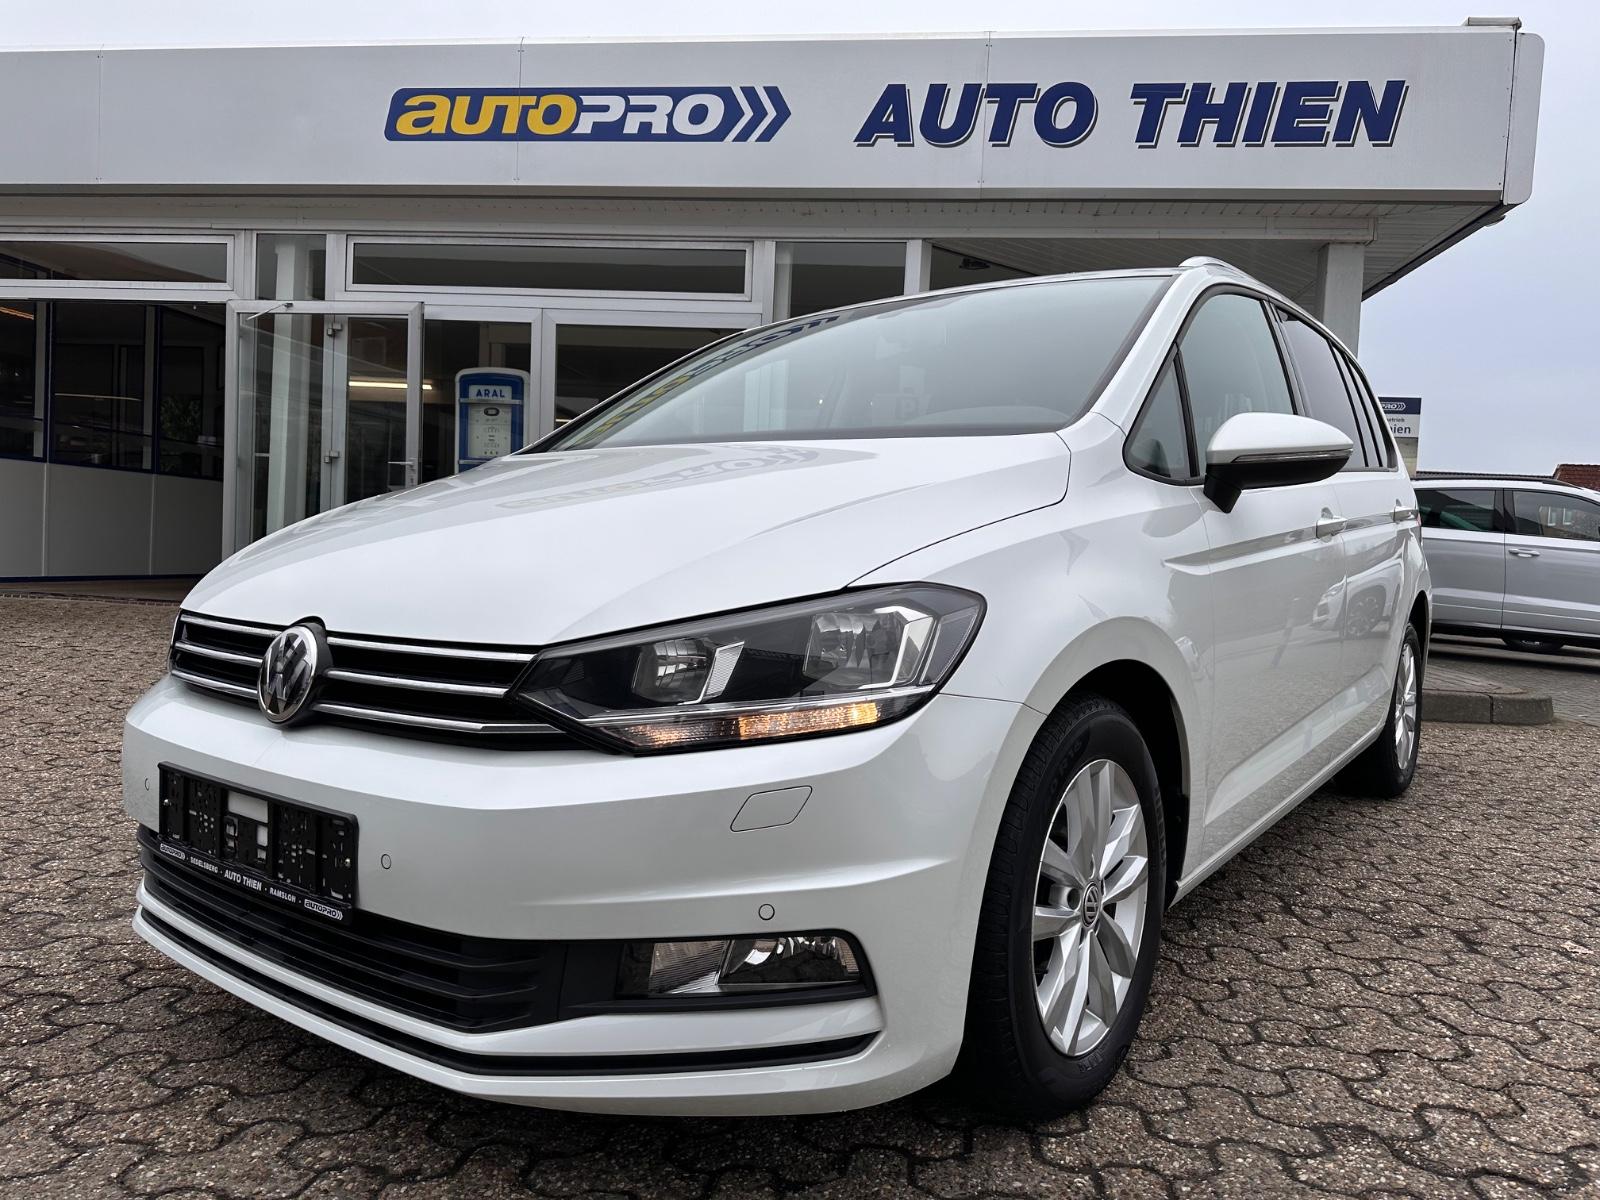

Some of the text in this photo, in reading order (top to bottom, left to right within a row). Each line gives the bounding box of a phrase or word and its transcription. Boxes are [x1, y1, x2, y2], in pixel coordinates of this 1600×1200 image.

[853, 80, 1409, 149] AUTO THIEN
[476, 389, 505, 398] ARAL
[224, 869, 242, 883] AUTO
[243, 876, 262, 891] THIEN
